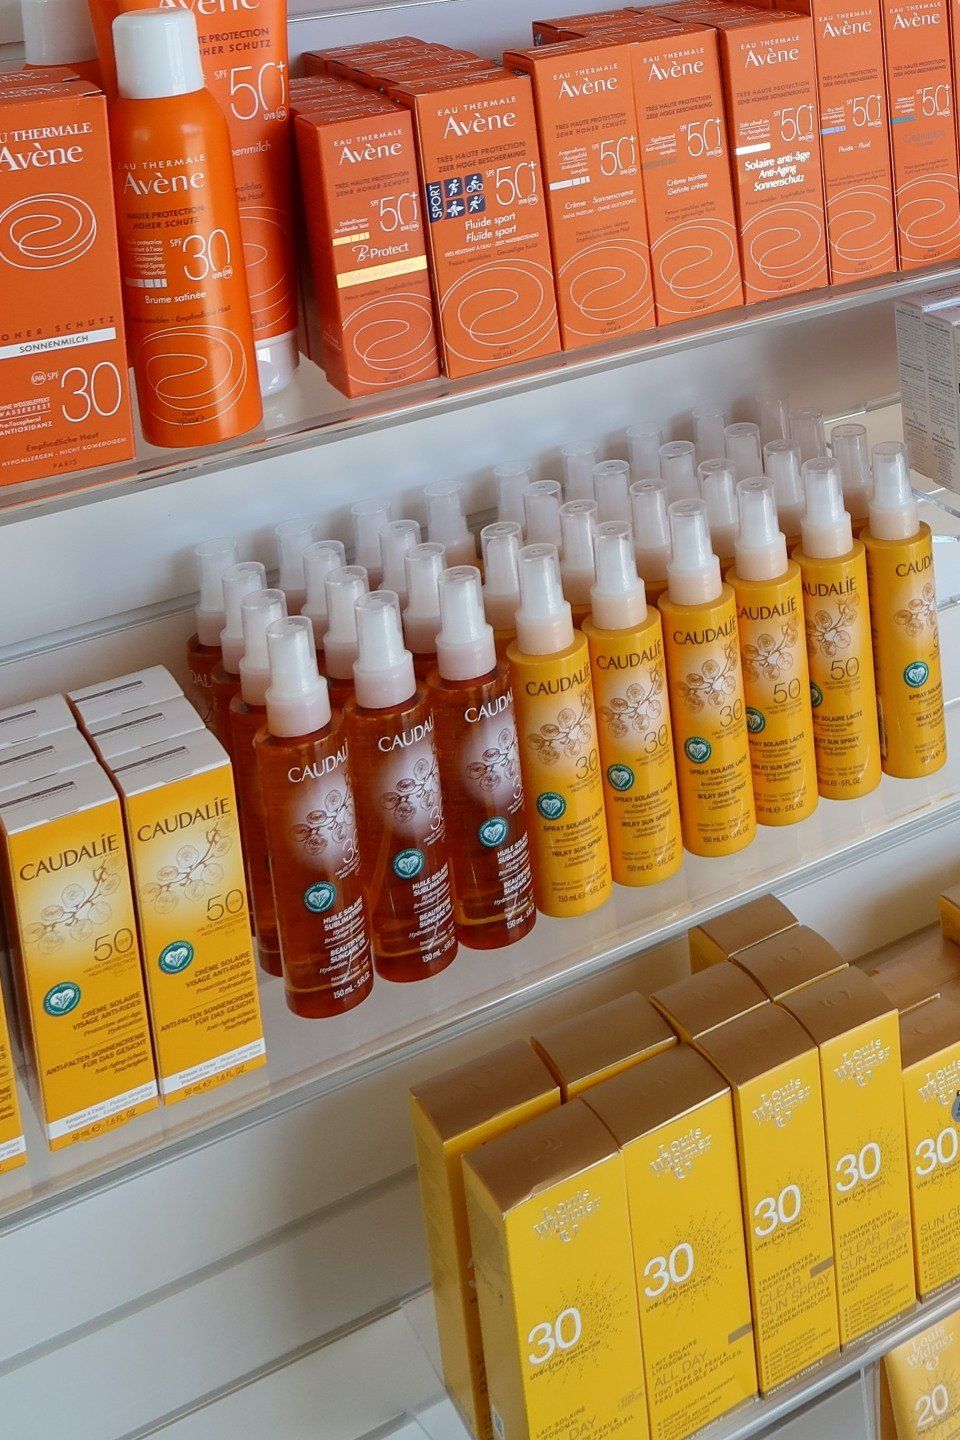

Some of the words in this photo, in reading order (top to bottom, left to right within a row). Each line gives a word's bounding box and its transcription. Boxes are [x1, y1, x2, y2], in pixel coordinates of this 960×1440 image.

[648, 59, 705, 83] Avène
[744, 46, 799, 68] Avène
[558, 75, 618, 100] Avène
[437, 107, 457, 117] EAU
[461, 96, 517, 115] THERMALE
[10, 122, 93, 142] THERMALE
[443, 110, 517, 139] Avène
[339, 141, 402, 166] Avène
[744, 156, 772, 171] Solaire
[774, 150, 811, 168] anti-âge
[123, 166, 206, 196] Avène
[753, 173, 805, 193] Sonnenschutz
[431, 185, 442, 219] SPORT
[19, 333, 89, 354] SONNENMILCH
[47, 370, 59, 381] SPF
[61, 362, 122, 422] 30
[829, 657, 860, 680] 50
[137, 795, 232, 845] CAUDALÍE
[19, 832, 120, 883] CAUDALÍE
[205, 888, 246, 923] 50
[93, 927, 135, 963] 50
[834, 1141, 882, 1195] 30
[913, 1126, 959, 1178] 30
[753, 1183, 801, 1239] 30
[643, 1241, 695, 1300] 30
[527, 1306, 583, 1367] 30
[915, 1383, 949, 1427] 20
